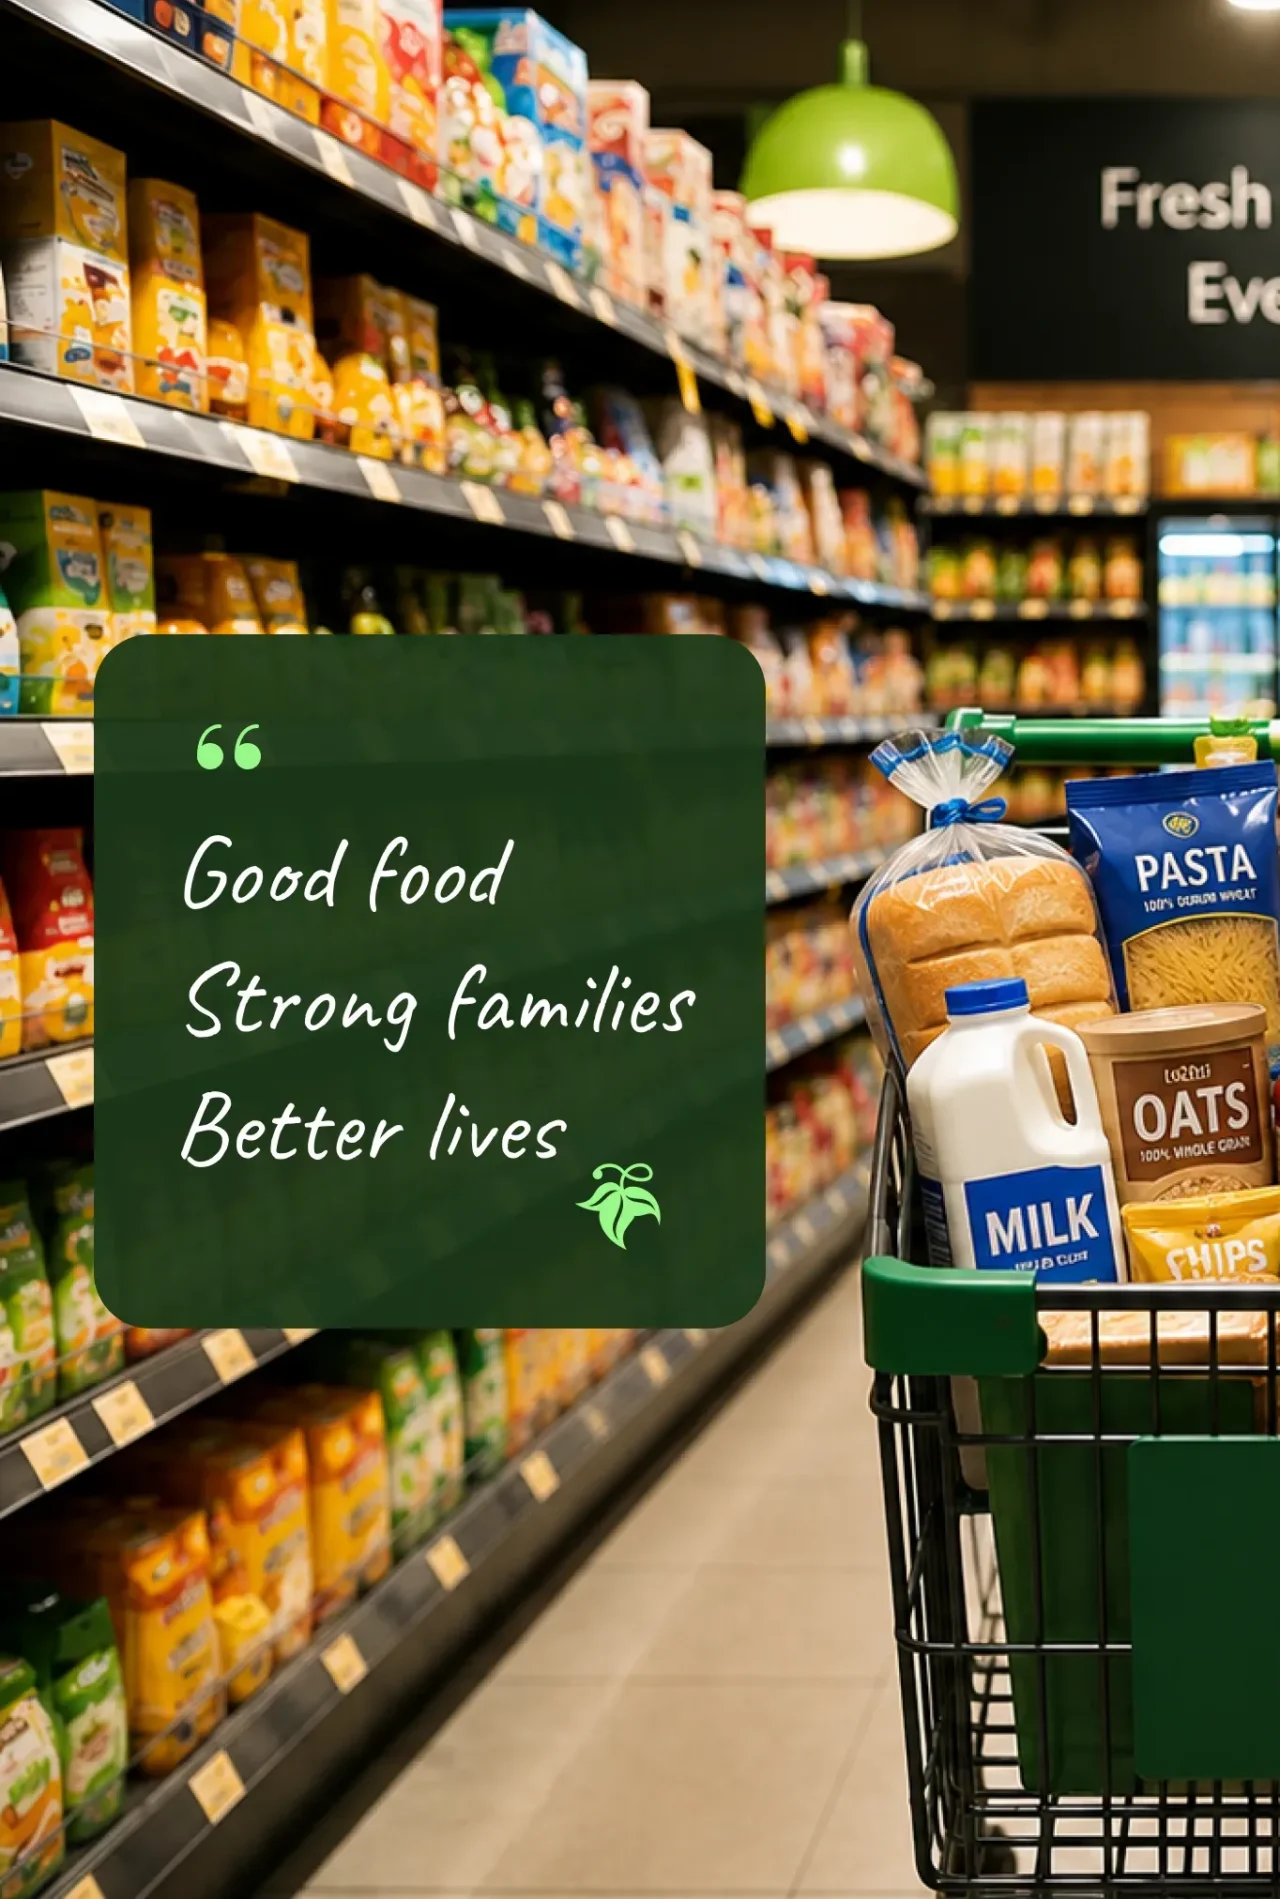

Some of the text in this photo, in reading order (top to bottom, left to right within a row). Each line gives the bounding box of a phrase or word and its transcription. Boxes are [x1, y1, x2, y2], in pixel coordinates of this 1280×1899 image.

[1101, 165, 1272, 230] Fresh
[1134, 843, 1258, 893] PASTA
[1133, 1081, 1250, 1142] OATS
[1173, 1140, 1216, 1159] WHOLE
[985, 1193, 1100, 1257] MILK
[1165, 1238, 1268, 1282] CHIPS
